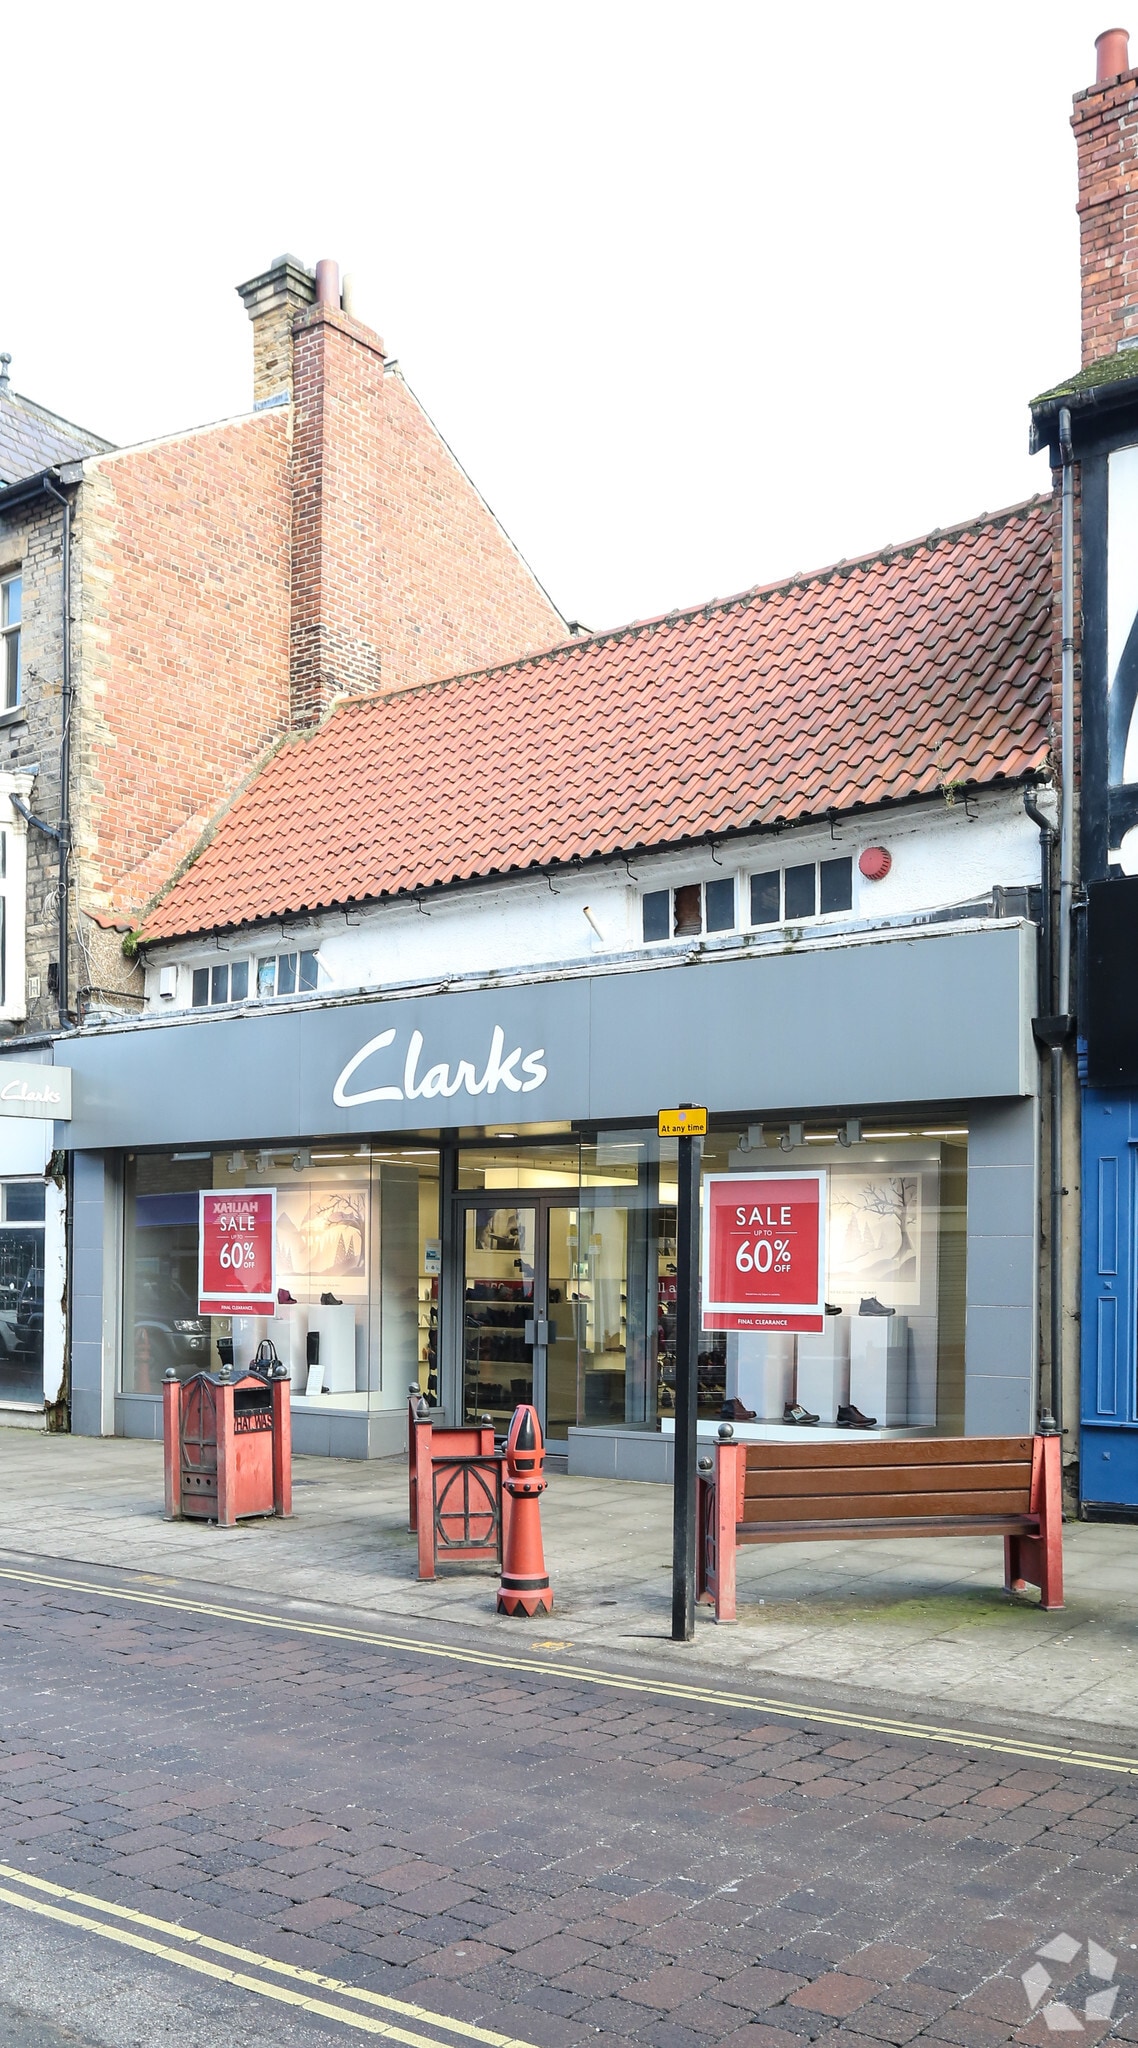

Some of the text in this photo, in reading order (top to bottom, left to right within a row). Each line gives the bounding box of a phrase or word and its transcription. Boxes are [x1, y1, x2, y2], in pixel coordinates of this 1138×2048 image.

[332, 1024, 548, 1108] Clarks
[0, 1080, 61, 1104] Clarks
[672, 1125, 685, 1133] any
[220, 1216, 255, 1232] SALE
[735, 1206, 792, 1226] SALE
[220, 1242, 255, 1269] 60%
[735, 1239, 792, 1273] 60%
[773, 1264, 791, 1273] OFF
